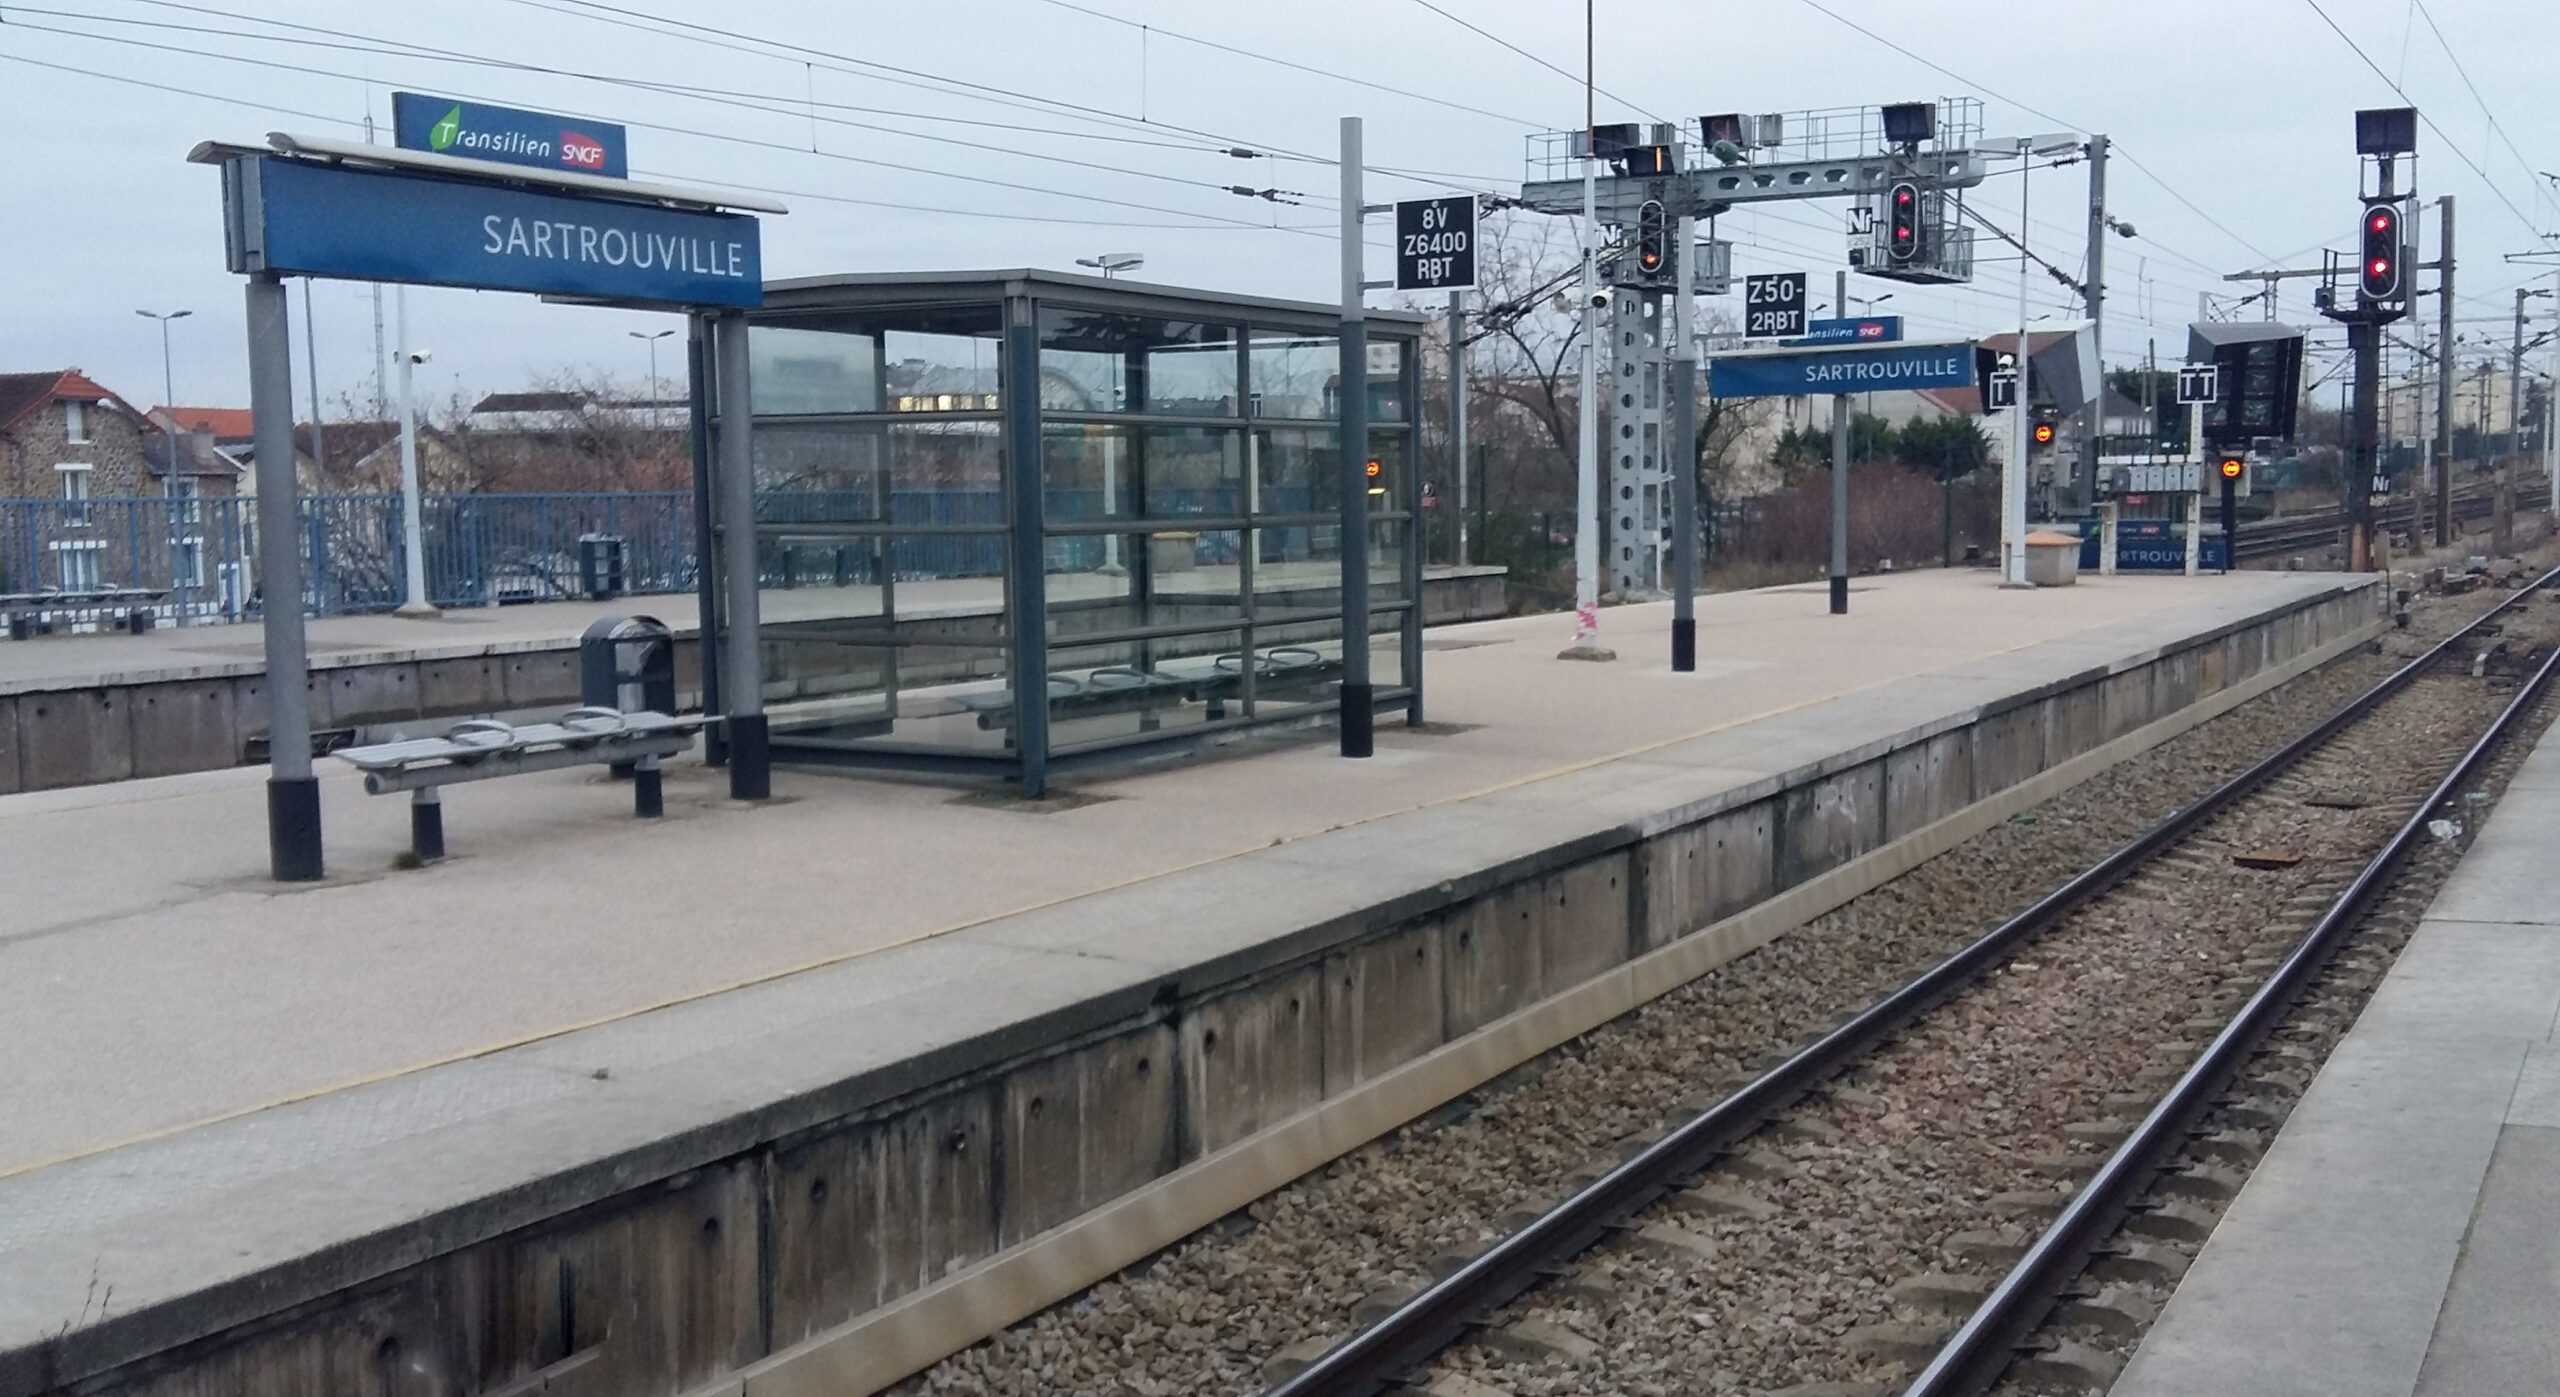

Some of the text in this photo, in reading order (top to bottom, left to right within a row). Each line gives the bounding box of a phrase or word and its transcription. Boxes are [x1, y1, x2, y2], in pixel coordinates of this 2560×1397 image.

[440, 121, 602, 164] Transilien SNCF
[1422, 206, 1449, 229] 8V
[483, 214, 744, 278] SARTROUVILLE
[1403, 231, 1467, 256] Z6400
[1417, 257, 1454, 280] RBT
[1748, 279, 1804, 304] Z50-
[1751, 310, 1799, 332] 2RBT
[1808, 328, 1854, 339] ansilien
[1805, 358, 1958, 382] SARTROUVILLE
[2118, 550, 2216, 562] RTROUVLE
